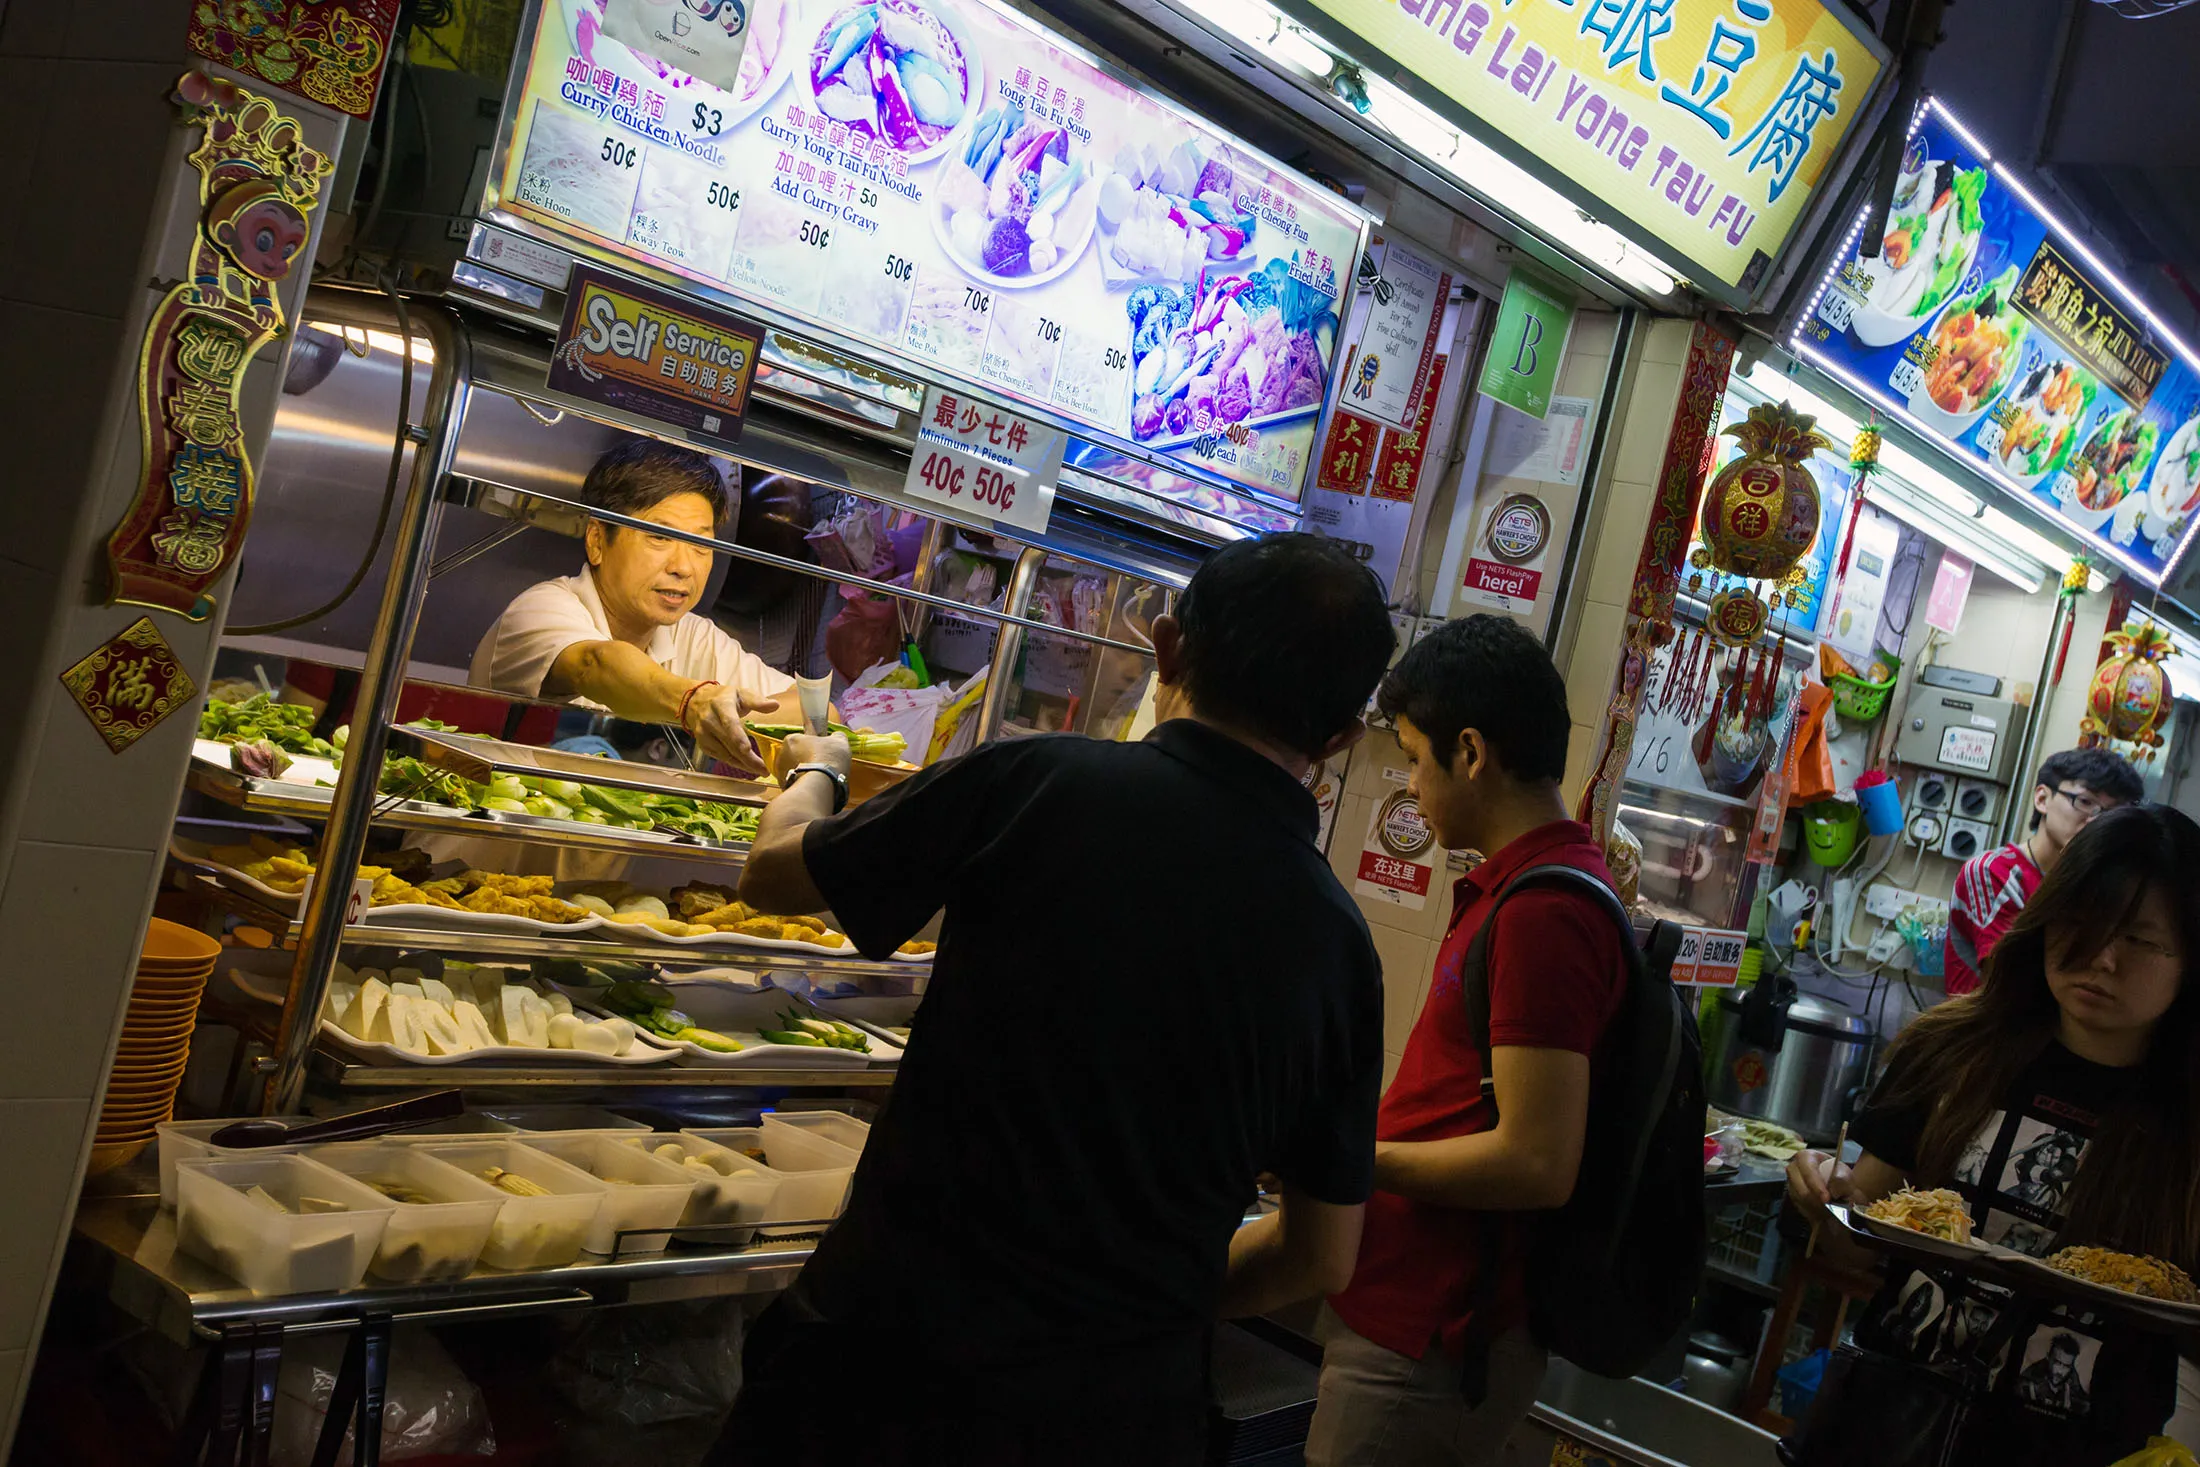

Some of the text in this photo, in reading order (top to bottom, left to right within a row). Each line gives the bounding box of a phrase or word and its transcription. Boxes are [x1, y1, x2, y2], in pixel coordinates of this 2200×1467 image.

[561, 82, 726, 166] Curry Chicken Noodle
[692, 101, 723, 136] $3
[999, 79, 1091, 144] Yong Tau Fu Soup
[601, 136, 637, 170] 50¢
[761, 116, 923, 202] Curry Yong Tau Fu Noodle
[524, 173, 551, 194] 米粉
[707, 181, 740, 213] 50¢
[521, 188, 572, 217] Bee Hoon
[770, 175, 879, 236] Add Curry Gravy
[1239, 194, 1309, 242] Chee Cheong Fun
[632, 230, 687, 260] Kway Teow
[799, 220, 830, 249] 50¢
[884, 254, 913, 282] 50¢
[1288, 261, 1339, 298] Fried Items
[731, 268, 789, 297] Yellow Noodle
[1394, 277, 1424, 299] Certificate
[964, 287, 990, 314] 70¢
[581, 295, 746, 372] Self Service
[1037, 317, 1062, 344] 70¢
[1390, 311, 1413, 329] For The
[908, 336, 939, 356] Mee Pok
[1509, 312, 1544, 377] B
[1104, 347, 1127, 372] 50¢
[1410, 338, 1434, 406] Singapore
[660, 355, 738, 397] 自助服务
[982, 365, 997, 379] Chee
[998, 371, 1022, 390] Cheong
[690, 387, 731, 406] THANK YOU
[1071, 398, 1081, 410] Bee
[1082, 402, 1099, 416] Hoon
[933, 394, 1029, 453] 最少七件
[920, 427, 1013, 466] Minimum 7 Pieces
[1192, 435, 1218, 460] 40¢
[1217, 448, 1237, 463] each
[920, 452, 1016, 512] 40¢ 50¢
[1509, 516, 1532, 527] NETS
[1520, 533, 1538, 543] CHOICE
[1476, 562, 1534, 581] Use NETS FlashPay
[1478, 571, 1524, 595] here!
[1727, 604, 1760, 637] 福
[1399, 810, 1421, 821] NETS
[1387, 823, 1428, 838] HAWKER'S CHOICE
[1374, 857, 1417, 882] 在这里
[1378, 873, 1393, 884] NETS
[1703, 940, 1741, 963] 自助服务
